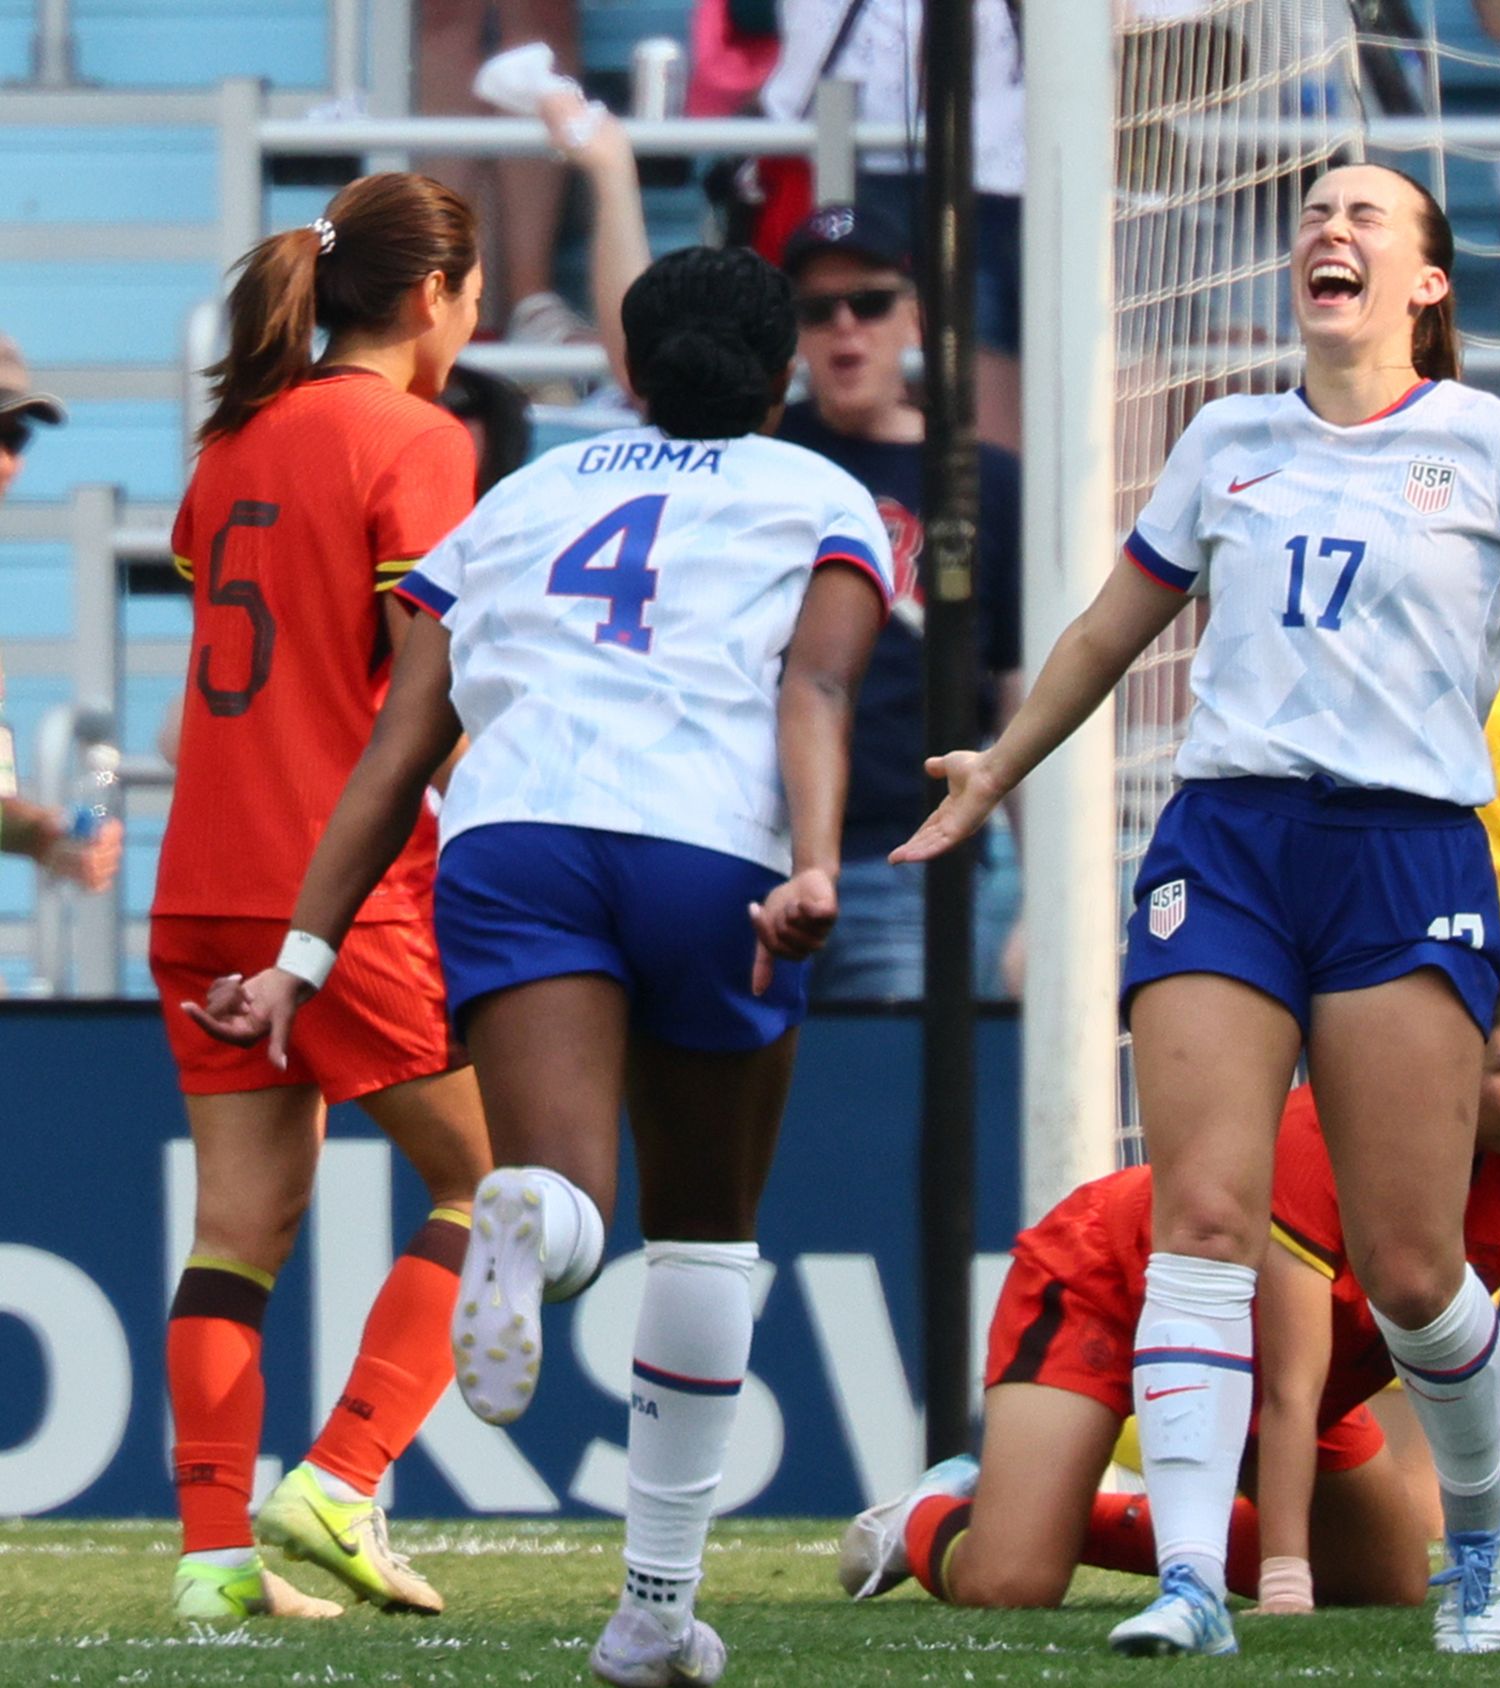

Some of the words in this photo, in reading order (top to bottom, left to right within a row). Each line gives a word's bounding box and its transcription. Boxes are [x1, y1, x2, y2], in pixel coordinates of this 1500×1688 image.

[577, 442, 722, 475] GIRMA
[1411, 464, 1452, 488] USA
[545, 493, 670, 656] 4
[1282, 534, 1367, 632] 17
[197, 499, 280, 717] 5
[1152, 882, 1182, 908] USA
